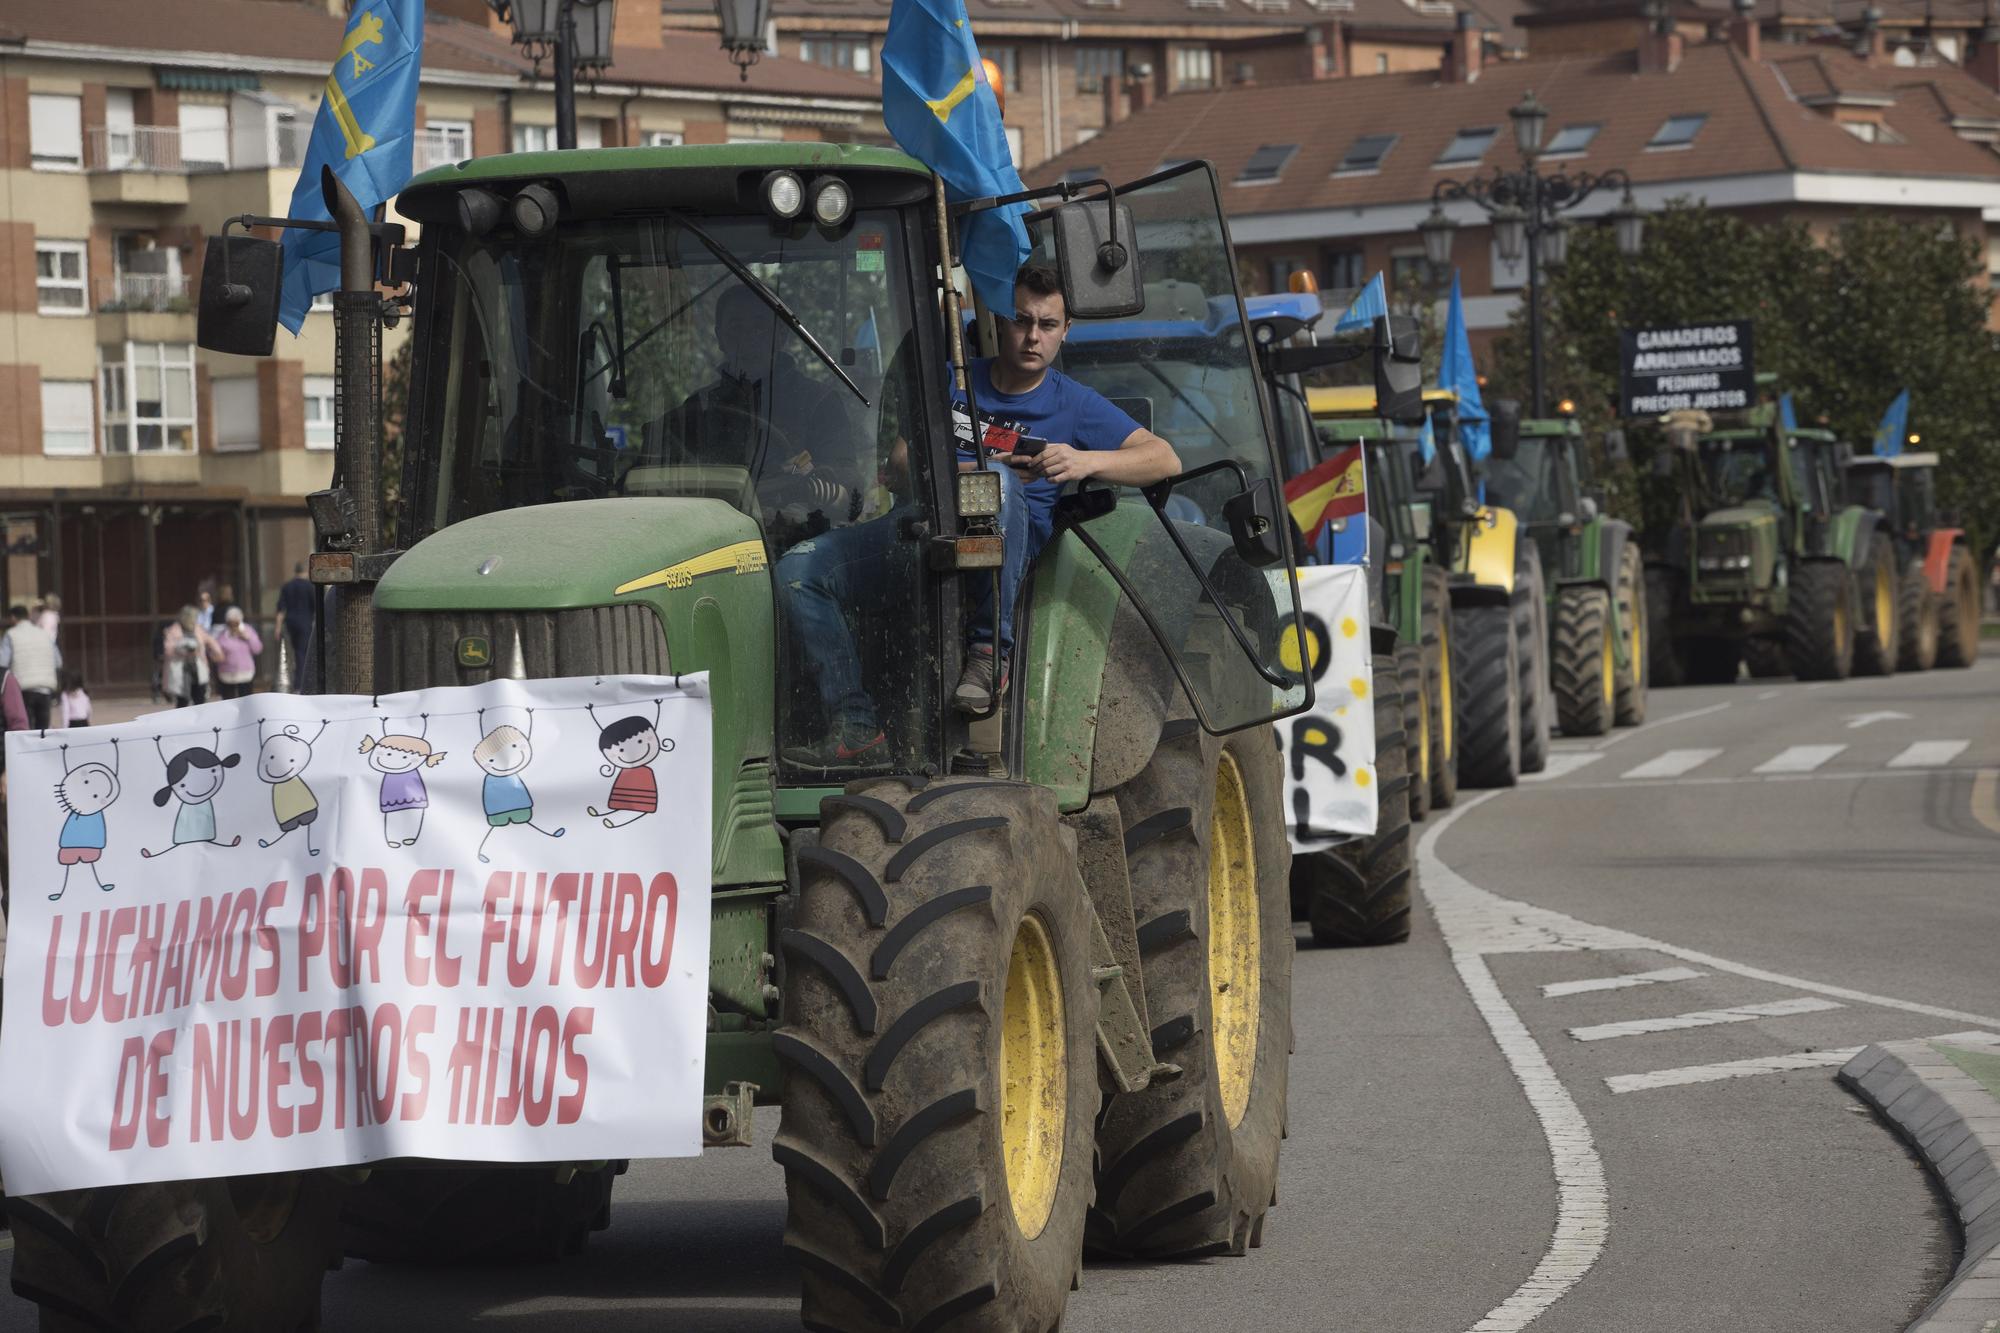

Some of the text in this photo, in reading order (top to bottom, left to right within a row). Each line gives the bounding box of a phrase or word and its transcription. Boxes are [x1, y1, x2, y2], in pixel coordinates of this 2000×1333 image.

[1637, 326, 1737, 349] GANADEROS
[1634, 347, 1742, 370] ARRUINADOS
[1657, 373, 1720, 391] PEDIMOS
[1632, 390, 1746, 412] PRECIOS JUSTOS
[959, 403, 1026, 432] TMMY
[41, 867, 679, 1027] LUCHAMOS POR EL FUTURO
[109, 1003, 594, 1151] DE NUESTROS HIJOS
